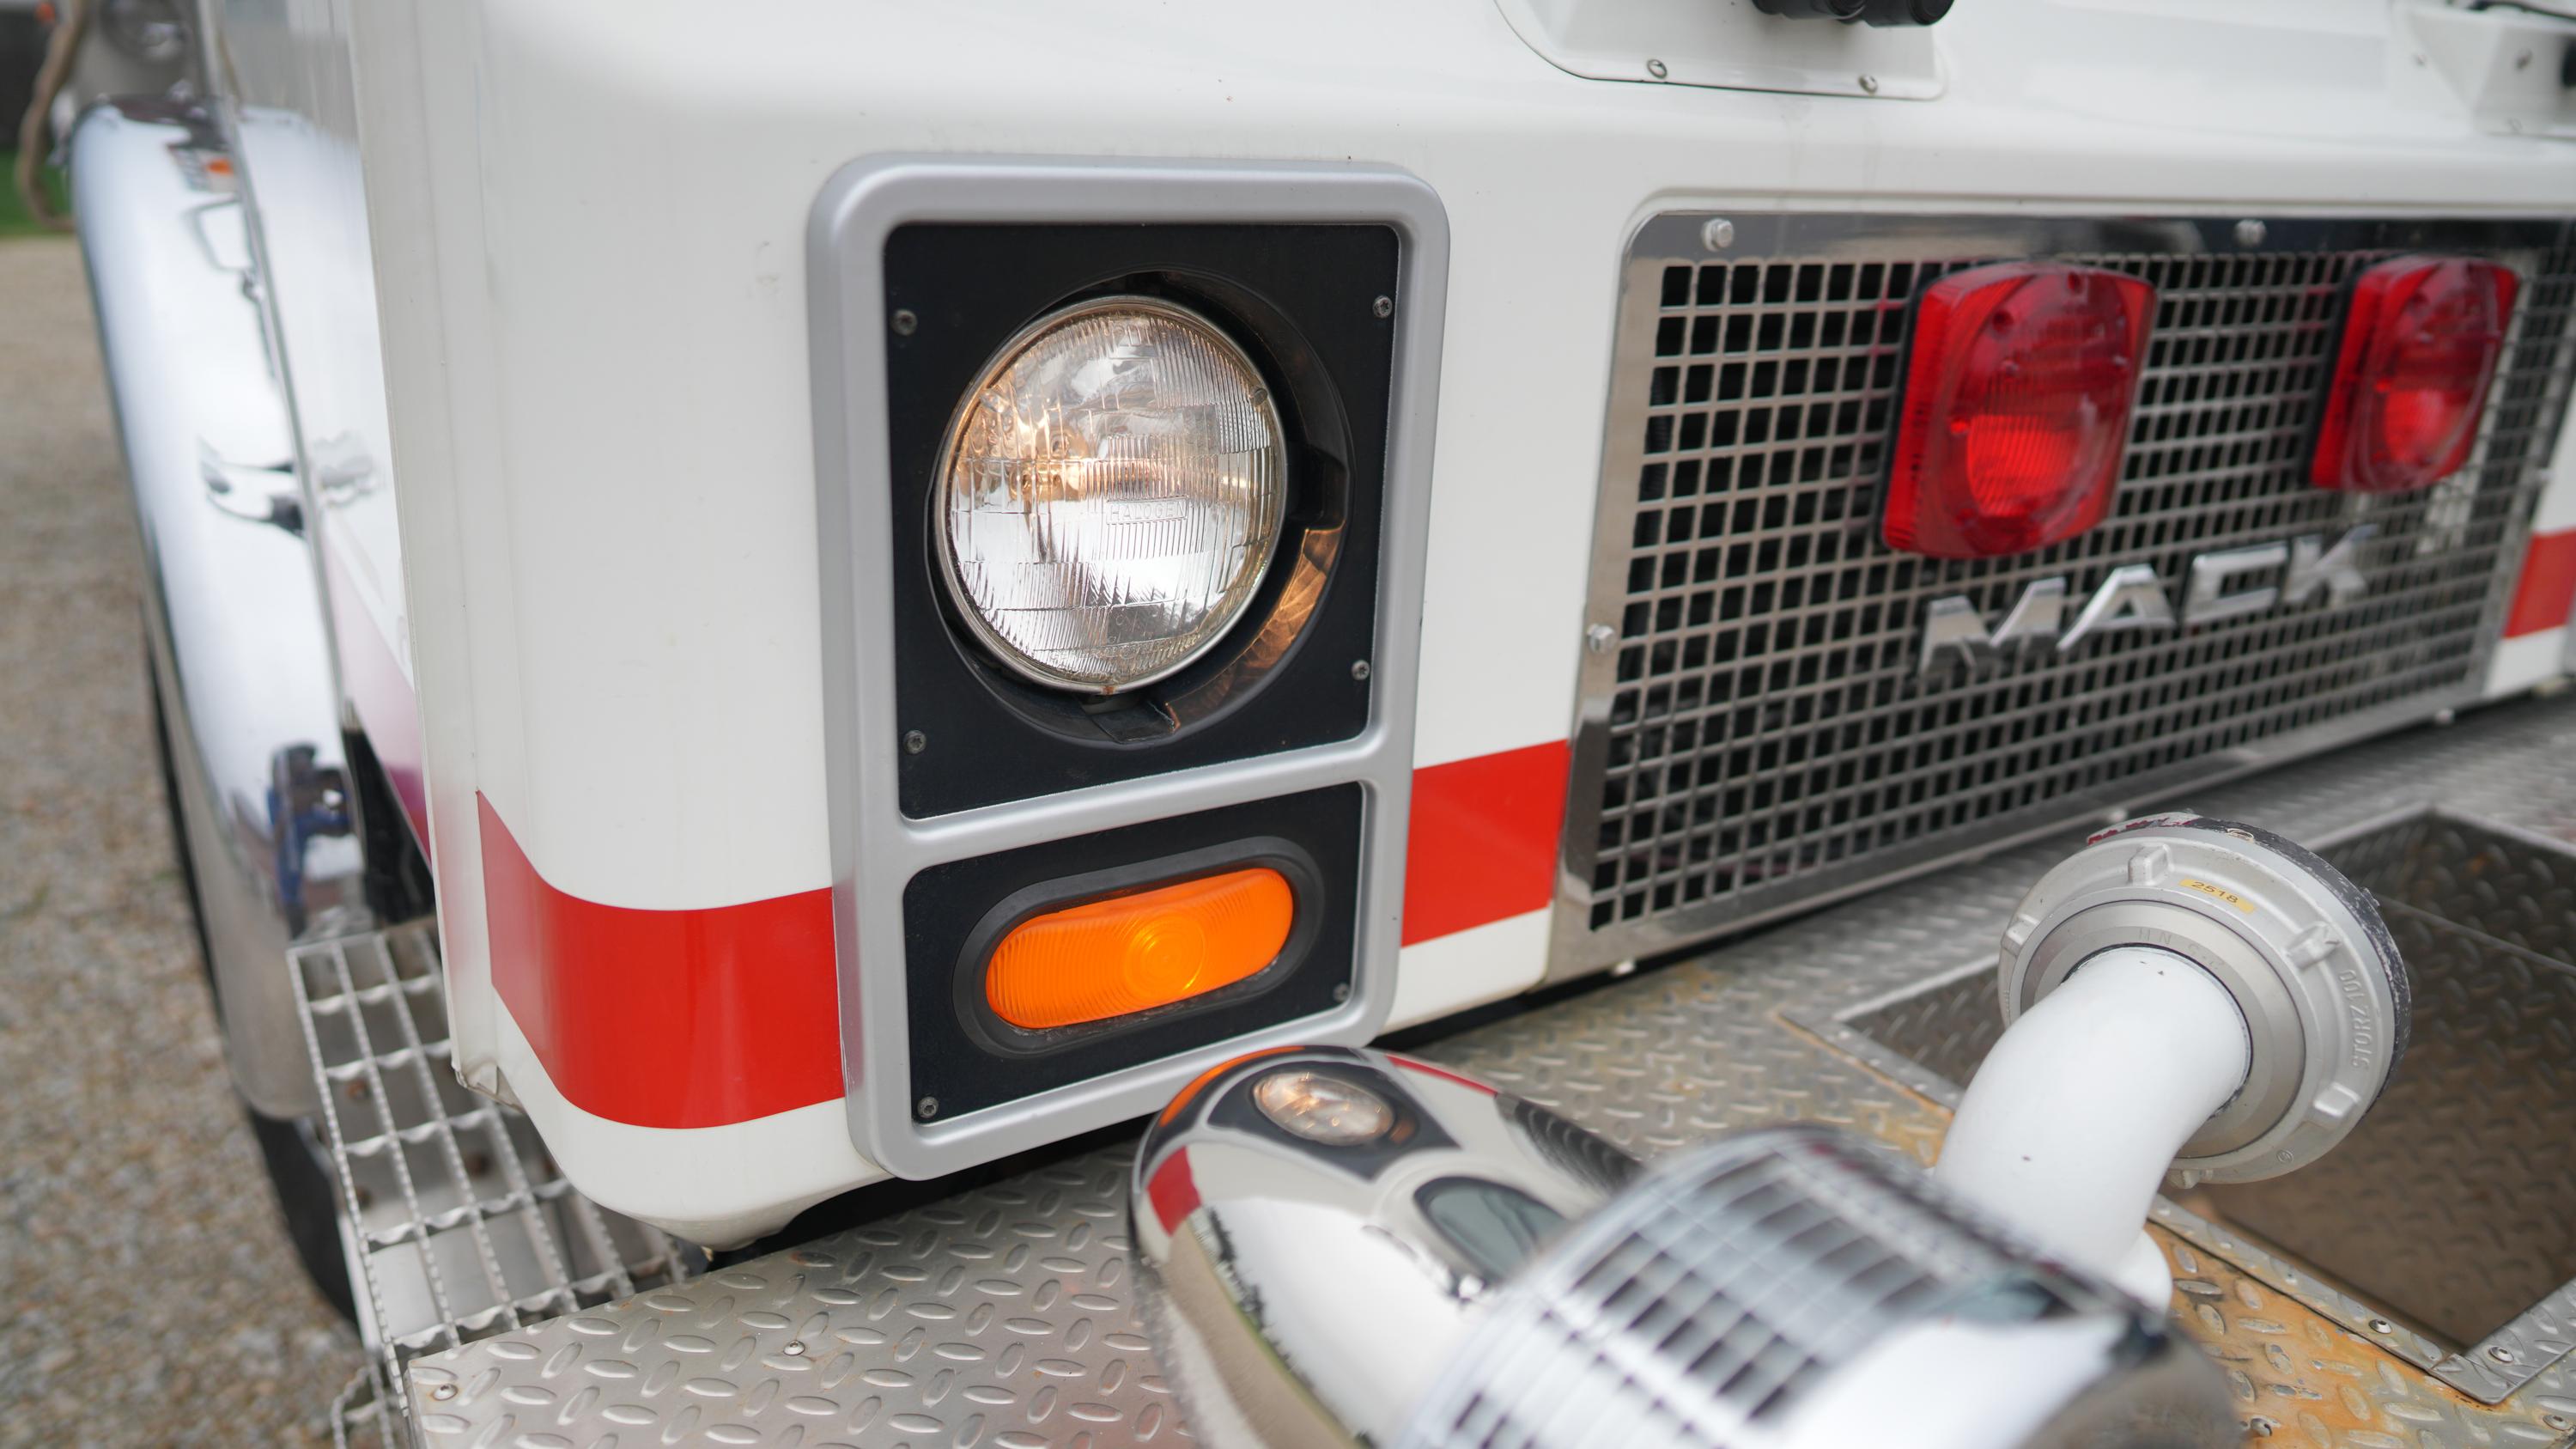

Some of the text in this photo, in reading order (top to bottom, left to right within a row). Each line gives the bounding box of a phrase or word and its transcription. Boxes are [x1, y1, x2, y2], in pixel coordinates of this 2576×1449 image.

[1109, 501, 1185, 521] HALOGEN
[1918, 524, 2378, 672] MACK
[2191, 881, 2239, 903] 2518
[2339, 969, 2372, 1067] STORZ 100
